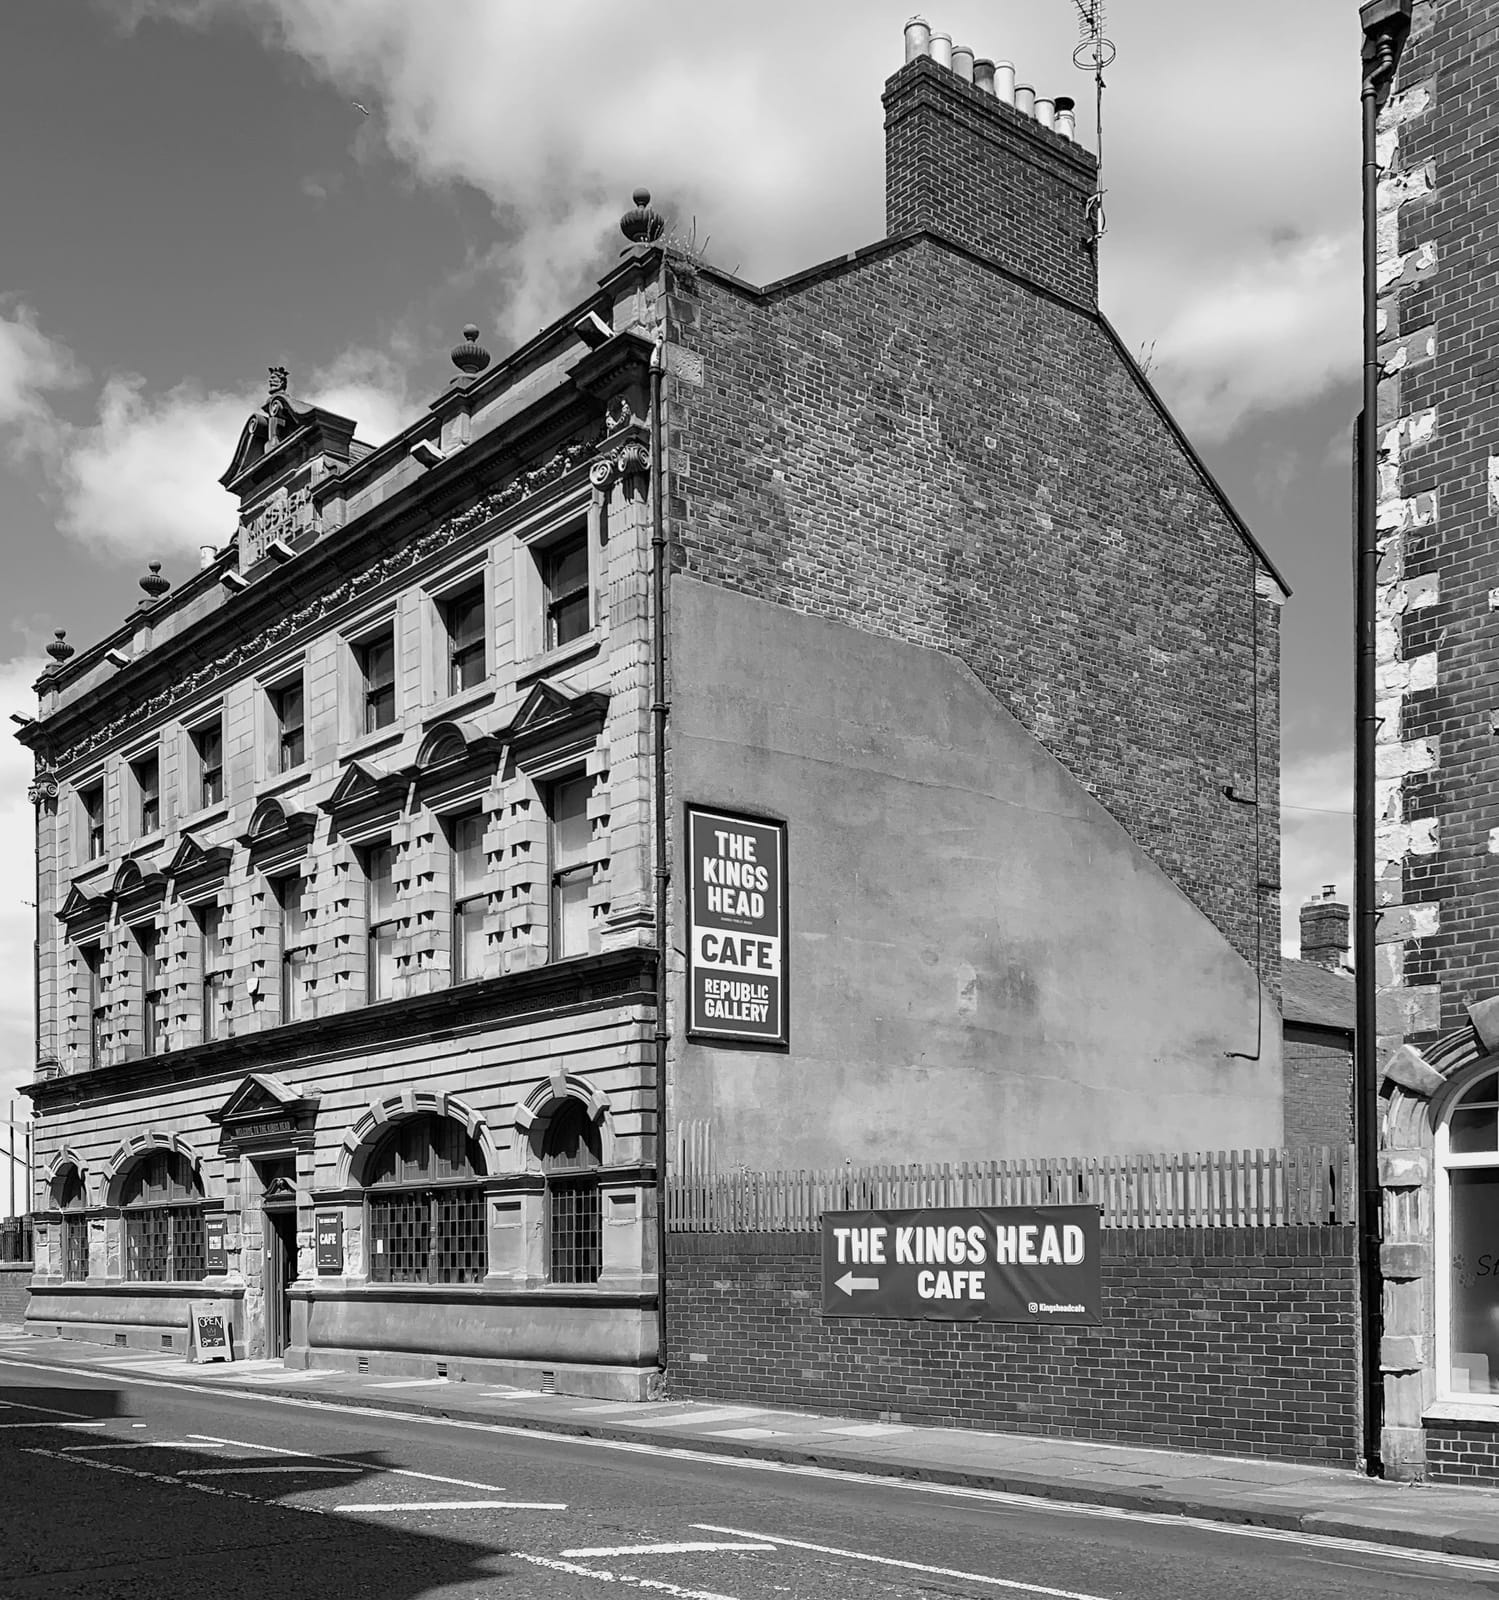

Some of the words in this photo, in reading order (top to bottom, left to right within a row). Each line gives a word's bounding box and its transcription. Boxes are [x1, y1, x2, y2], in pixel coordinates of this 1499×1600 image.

[714, 831, 757, 862] THE
[703, 857, 769, 892] KINGS
[707, 886, 765, 919] HEAD
[701, 934, 773, 970] CAFE
[705, 979, 769, 1002] REPUBLIC
[705, 999, 769, 1023] GALLERY
[320, 1232, 336, 1245] CAFE
[833, 1227, 888, 1265] THE
[896, 1226, 987, 1265] KINGS
[996, 1225, 1085, 1265] HEAD
[917, 1270, 986, 1300] CAFE
[199, 1317, 223, 1328] OPEN
